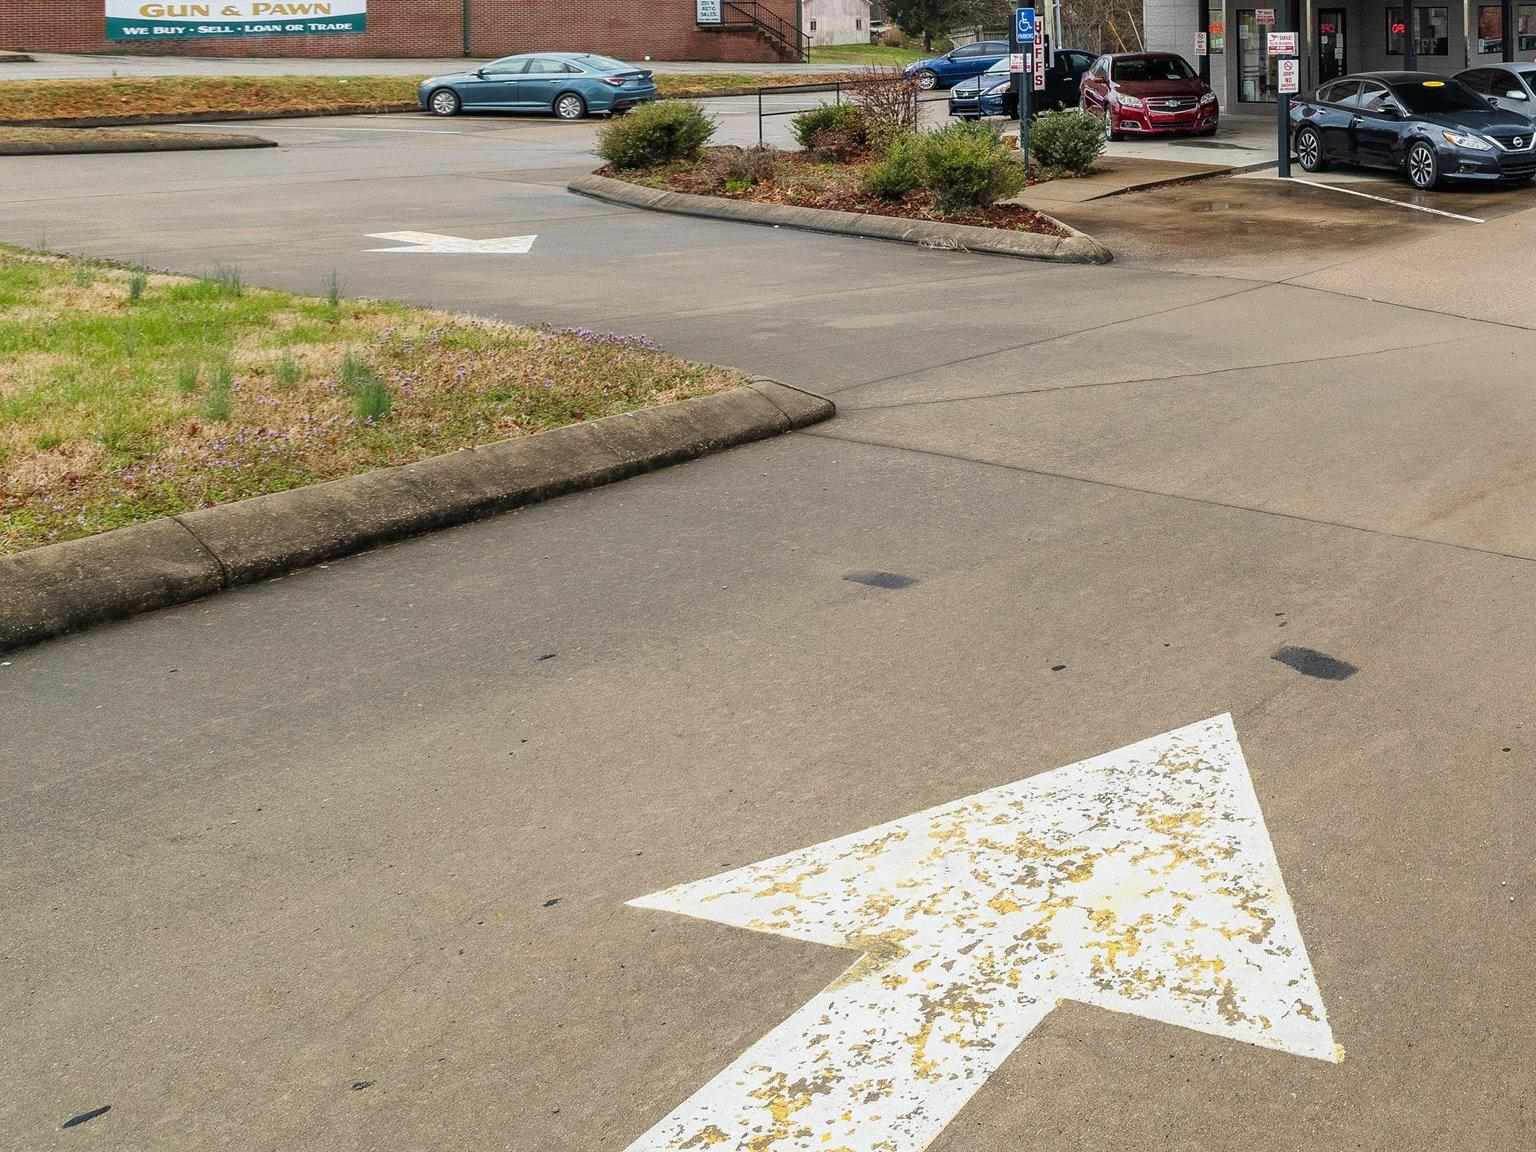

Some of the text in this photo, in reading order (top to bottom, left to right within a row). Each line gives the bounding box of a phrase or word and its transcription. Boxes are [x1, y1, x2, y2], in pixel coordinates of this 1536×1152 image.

[139, 2, 331, 17] GUN & PAWN
[122, 27, 149, 35] WE
[197, 25, 234, 33] SELL
[244, 25, 282, 33] LOAN
[307, 23, 353, 31] TRADE
